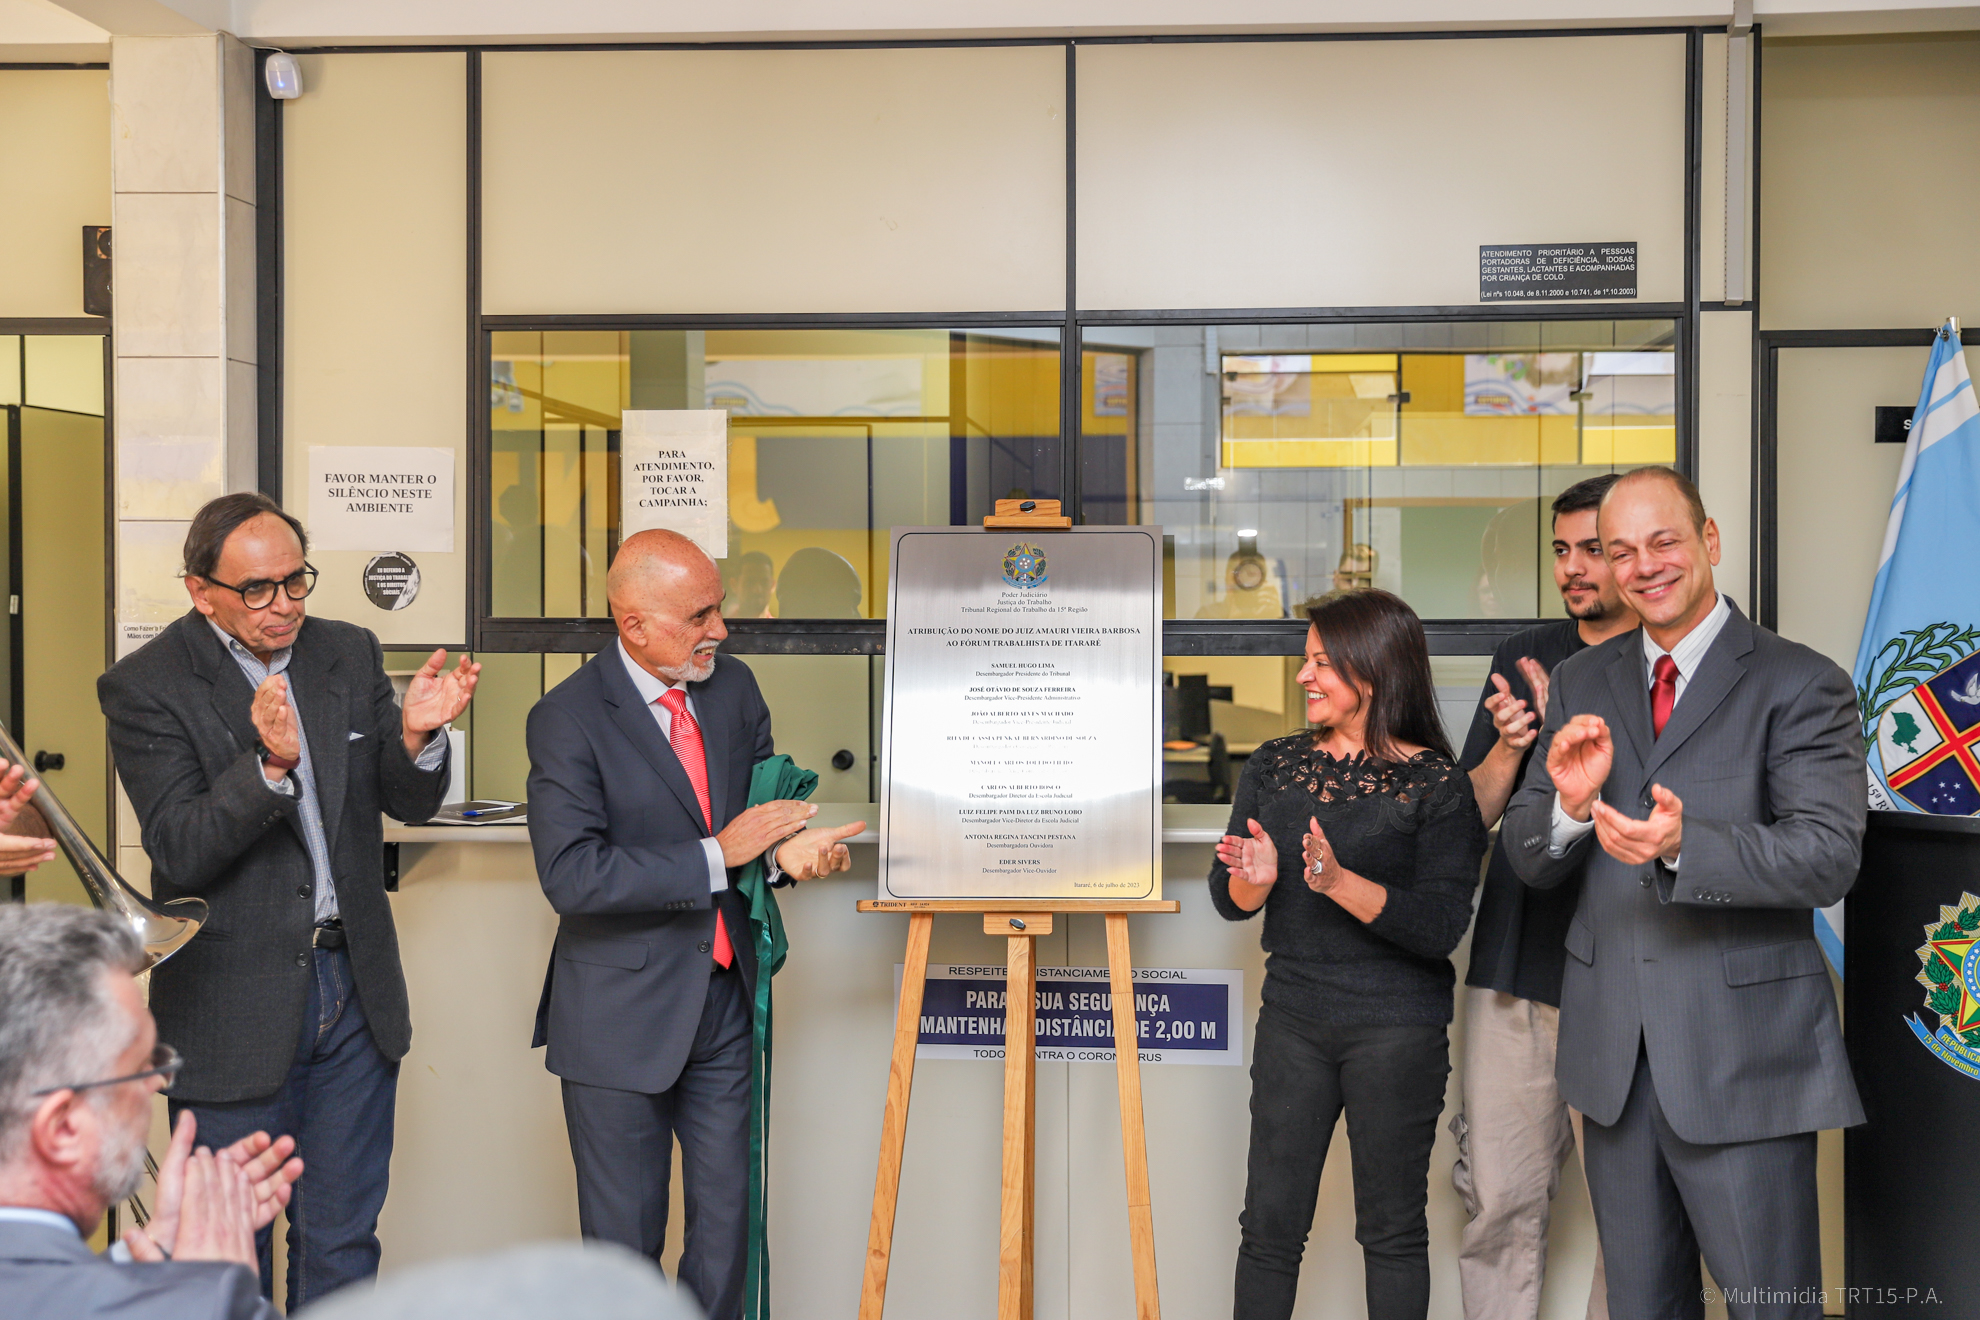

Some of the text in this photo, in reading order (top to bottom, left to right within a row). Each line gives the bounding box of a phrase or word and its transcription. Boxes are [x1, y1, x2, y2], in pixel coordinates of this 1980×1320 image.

[1481, 250, 1532, 258] ATENDIMENTO
[1538, 248, 1584, 256] PRIORITÁRIO
[1601, 247, 1635, 255] PESSOAS
[1481, 258, 1530, 266] PORTADORAS
[1553, 256, 1600, 264] DEFICIÊNCIA,
[1606, 256, 1635, 264] IDOSAS,
[1482, 266, 1525, 274] GESTANTES,
[1527, 265, 1568, 273] LACTANTES
[1575, 264, 1635, 272] ACOMPANHADAS
[1498, 274, 1530, 283] CRIANÇA
[1543, 273, 1566, 281] COLO.
[1480, 291, 1492, 299] (Lei
[1504, 290, 1525, 298] 10.048,
[658, 450, 686, 459] PARA
[633, 461, 715, 471] ATENDIMENTO,
[325, 473, 437, 484] FAVOR MANTER O
[642, 474, 704, 483] POR FAVOR,
[328, 486, 432, 499] SILÊNCIO NESTE
[650, 486, 687, 495] TOCAR
[639, 498, 708, 507] CAMPAINHA;
[346, 503, 414, 513] AMBIENTE
[1068, 606, 1088, 614] Região
[907, 626, 959, 636] ATRIBUIÇÃO
[960, 638, 991, 647] FÓRUM
[1064, 638, 1101, 647] ITARARÉ
[948, 966, 1188, 980] RESPEITE SOCIAL
[1035, 1014, 1114, 1038] DISTÂNCI
[1155, 1020, 1195, 1043] 2,00
[1200, 1022, 1216, 1040] M
[1066, 1051, 1076, 1060] O
[1923, 1034, 1979, 1076] 15 de Novembro
